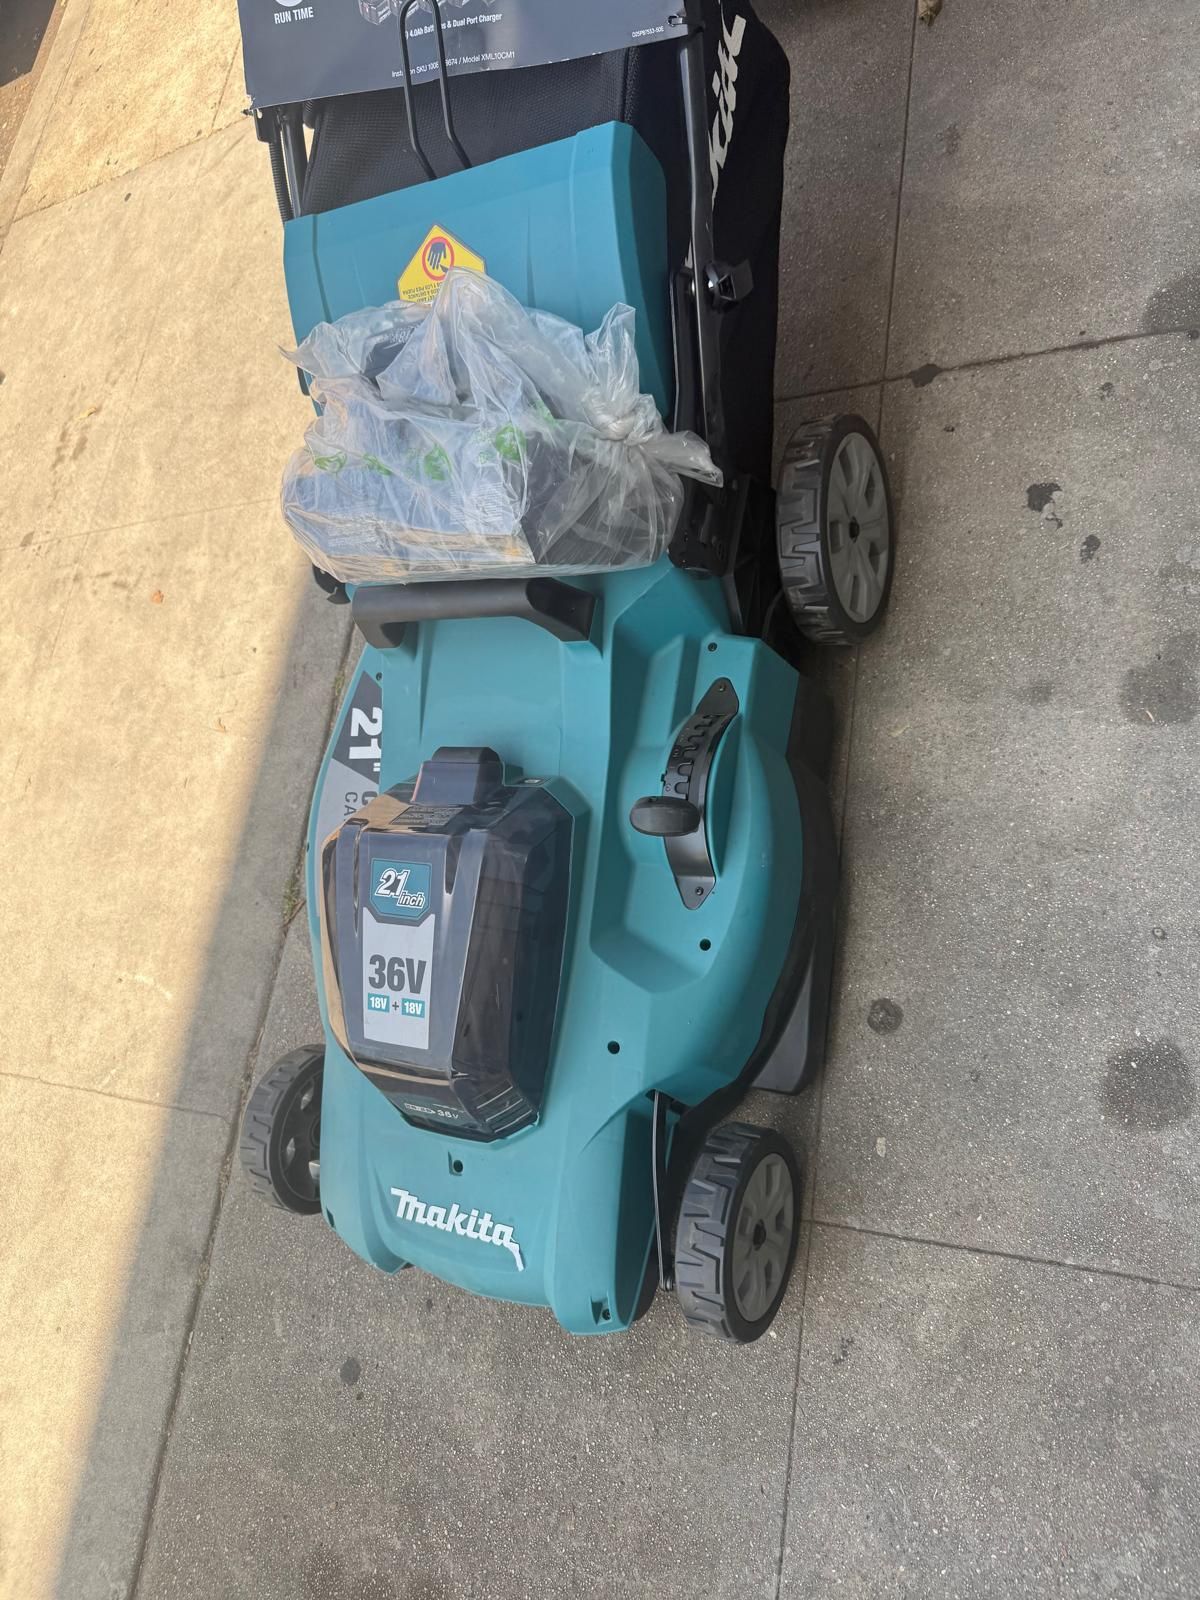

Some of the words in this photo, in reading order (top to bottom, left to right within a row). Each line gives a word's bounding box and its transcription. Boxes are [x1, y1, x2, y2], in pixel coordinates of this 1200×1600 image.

[274, 10, 292, 24] RUN
[292, 6, 314, 21] TIME
[409, 27, 424, 37] 4.0Ah
[446, 21, 452, 29] &
[452, 18, 466, 28] Dual
[466, 16, 478, 25] Port
[478, 13, 503, 24] Charger
[416, 65, 428, 74] SKU
[462, 55, 481, 64] Model
[349, 706, 383, 772] 21"
[375, 868, 410, 897] 21
[398, 891, 425, 908] inch
[368, 953, 427, 994] 36V
[369, 996, 388, 1010] 18V
[404, 1000, 423, 1015] 18V
[390, 1186, 525, 1272] Makita
